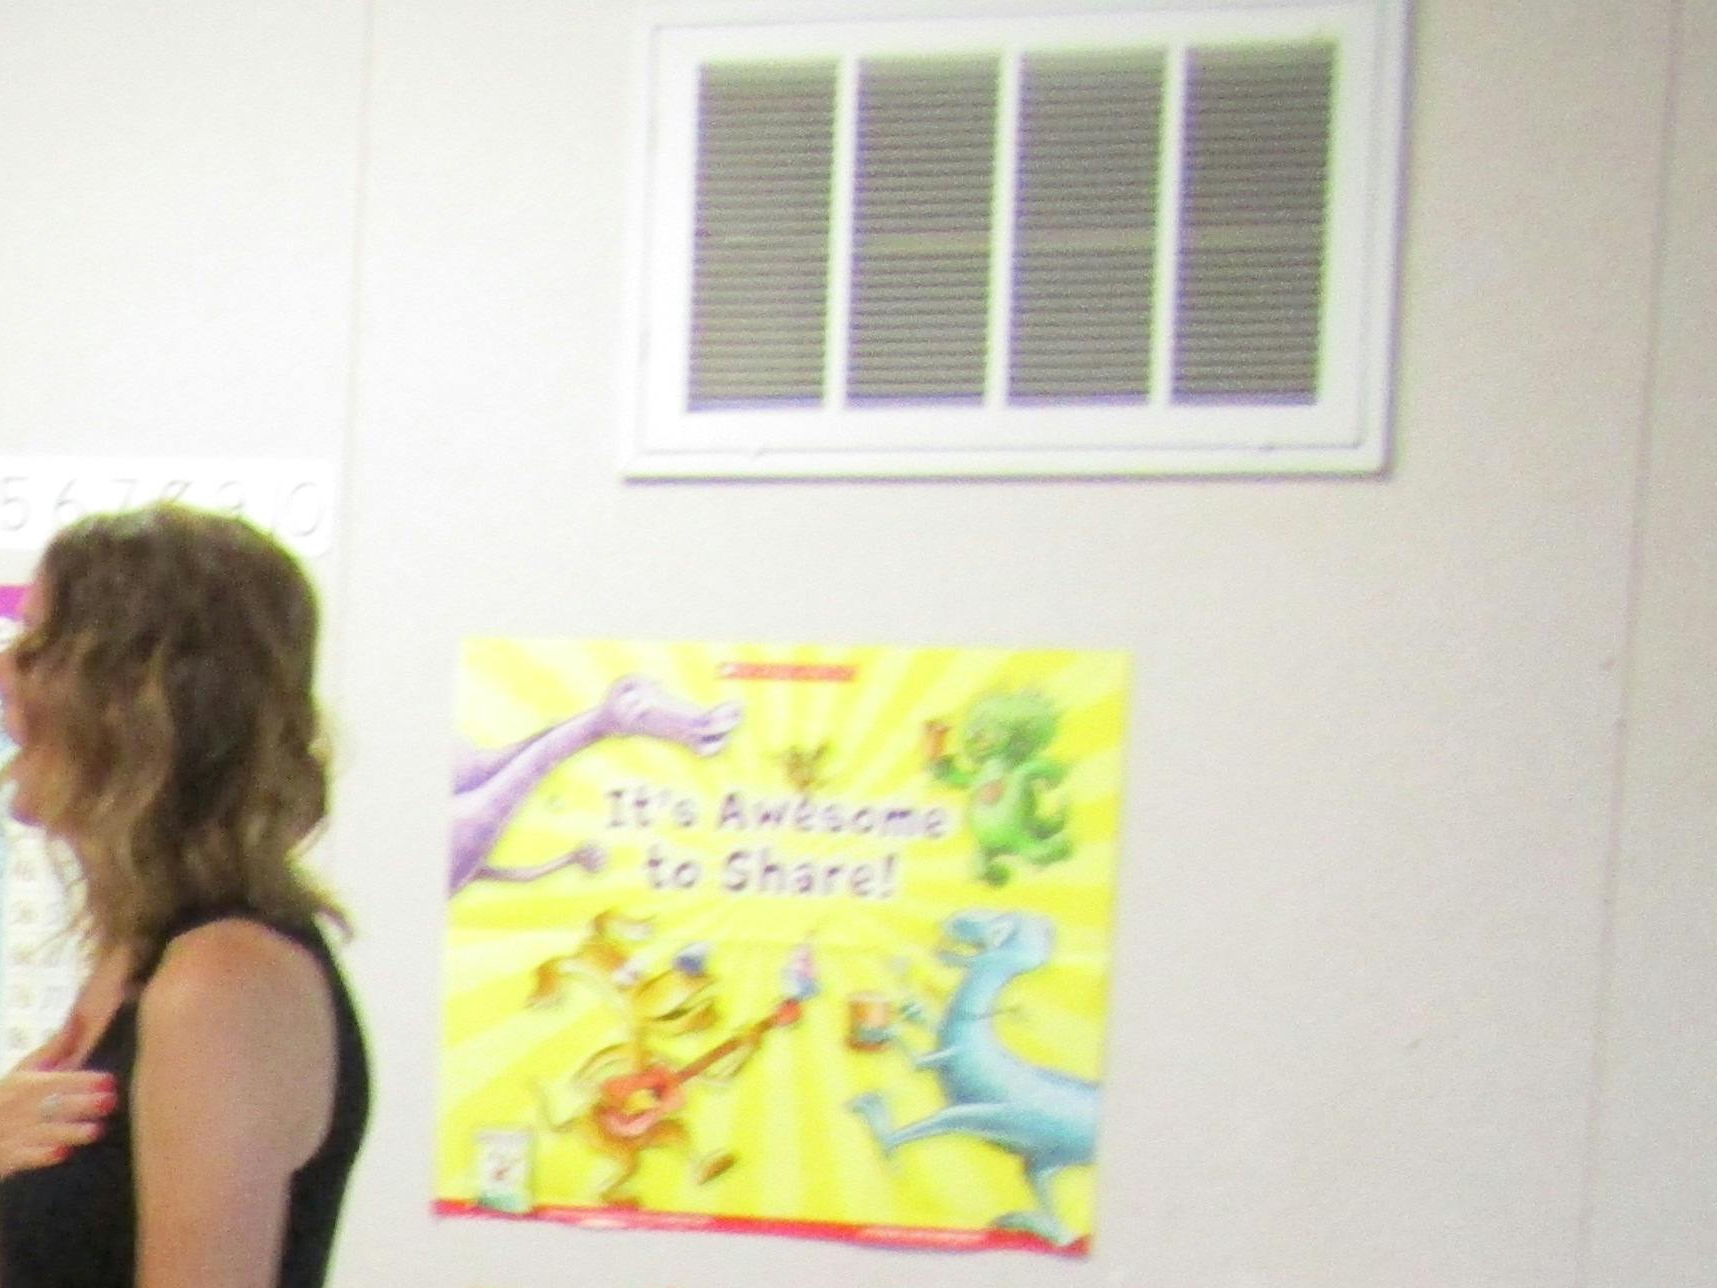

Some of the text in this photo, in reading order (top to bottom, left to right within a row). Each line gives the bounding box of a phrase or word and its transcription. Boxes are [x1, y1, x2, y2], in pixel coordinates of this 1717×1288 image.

[606, 787, 949, 840] It's Awesome
[647, 846, 897, 900] to Share!
